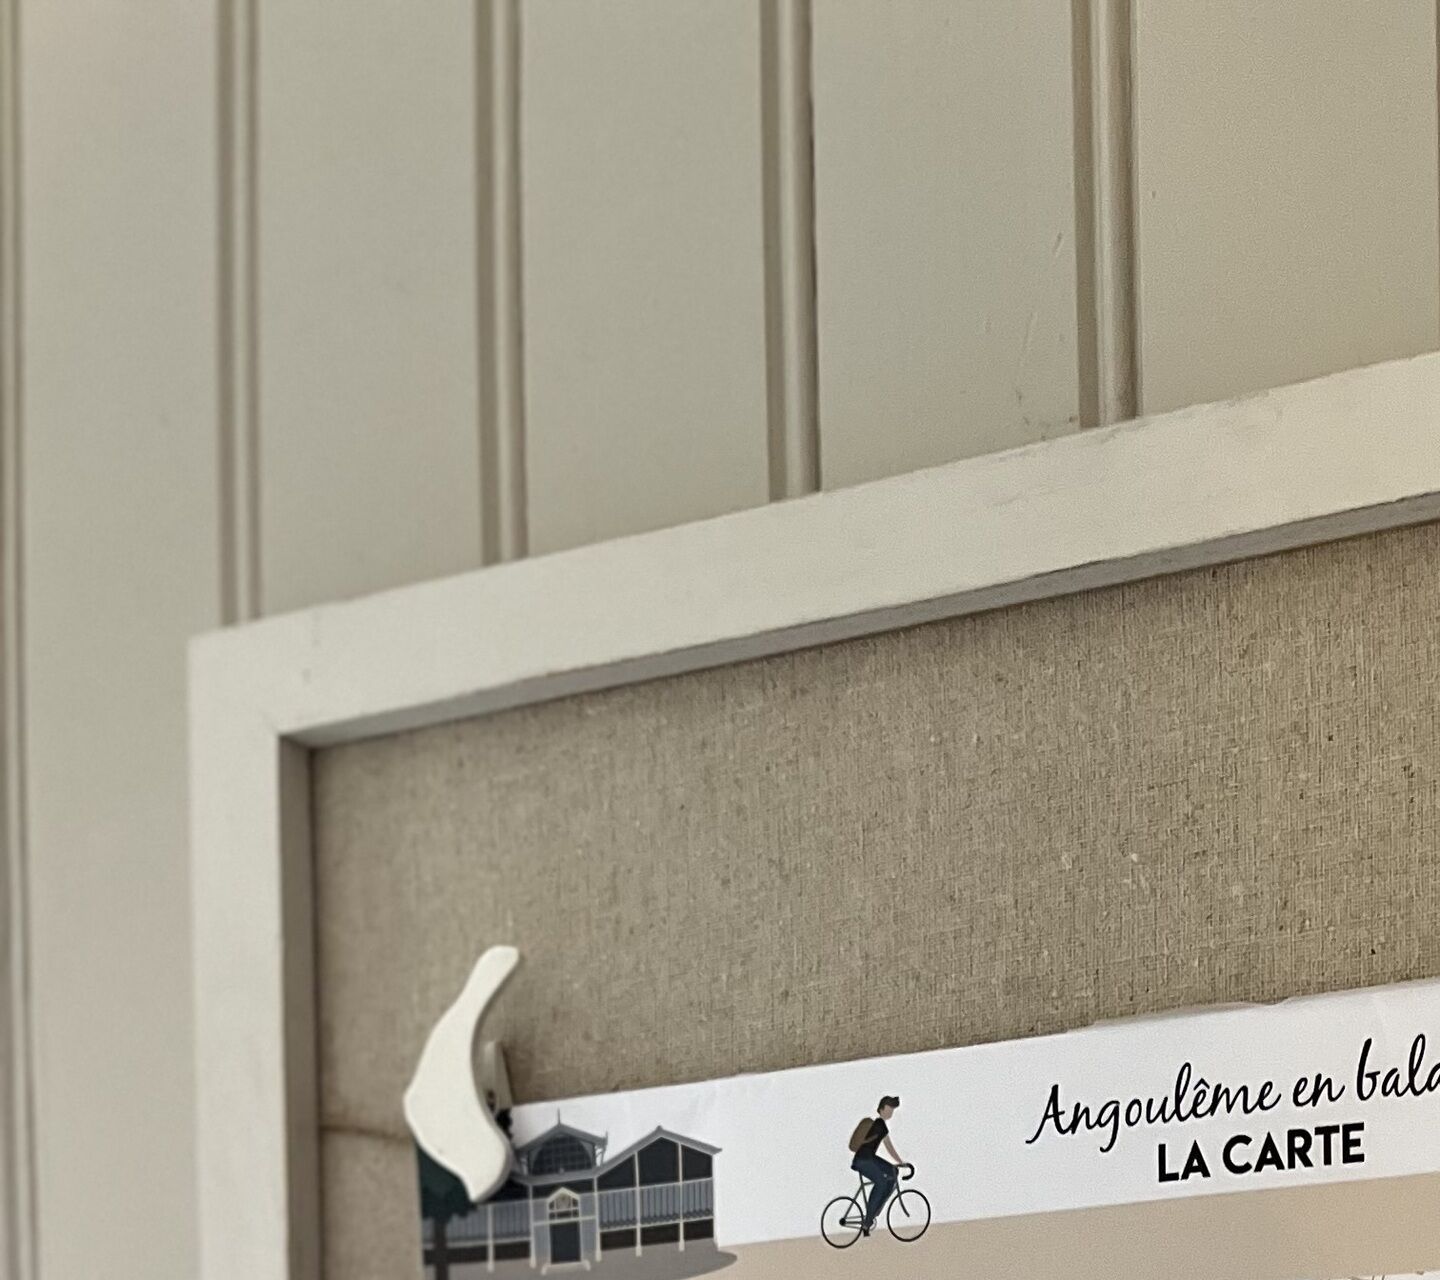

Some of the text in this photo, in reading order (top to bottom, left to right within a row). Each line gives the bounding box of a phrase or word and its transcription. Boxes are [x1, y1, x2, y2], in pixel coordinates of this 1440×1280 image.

[1025, 1061, 1283, 1154] Angoulême
[1293, 1073, 1345, 1107] en
[1158, 1122, 1365, 1183] LA CARTE
